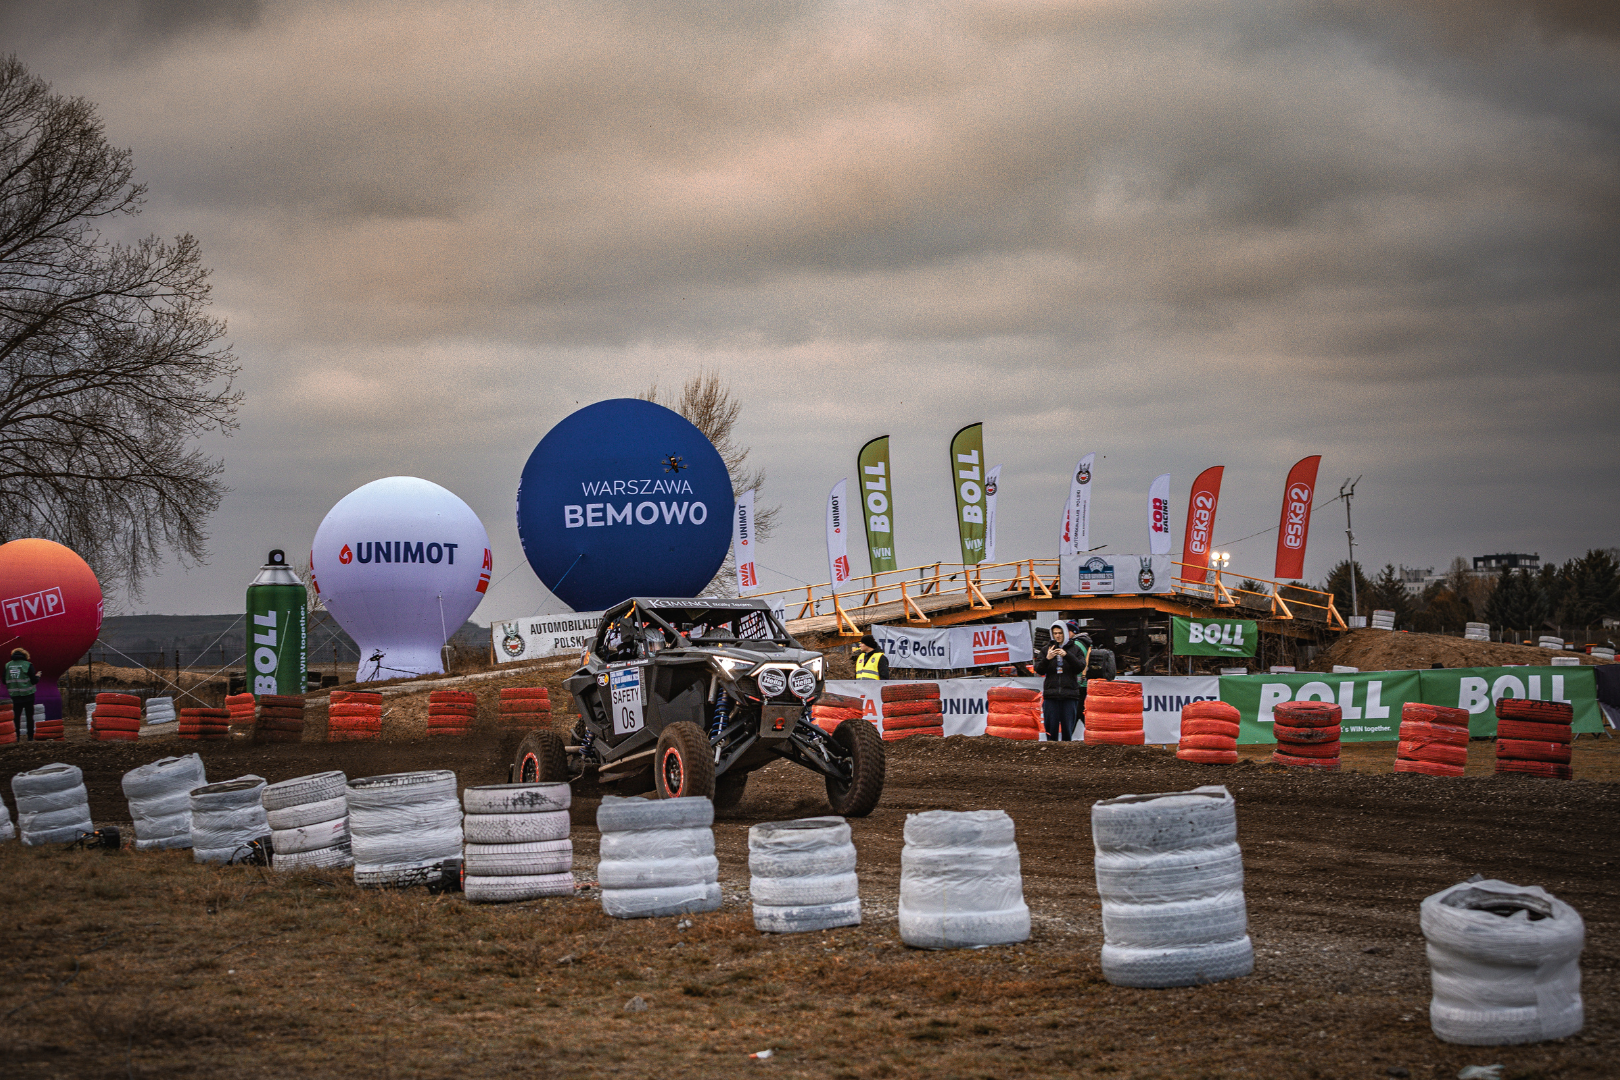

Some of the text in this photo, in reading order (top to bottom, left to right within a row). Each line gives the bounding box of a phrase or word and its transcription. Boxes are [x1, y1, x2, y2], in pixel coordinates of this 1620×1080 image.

[582, 479, 693, 496] WARSZAWA
[864, 461, 890, 532] BOLL
[957, 449, 983, 524] BOLL
[564, 501, 707, 528] BEMOWO
[739, 504, 748, 539] UNIMOT
[832, 495, 840, 527] UNIMOT
[1152, 498, 1163, 533] top
[1192, 496, 1213, 552] eska2
[1287, 488, 1308, 547] eska2
[357, 541, 458, 565] UNIMOT
[873, 547, 891, 558] WIN
[6, 594, 58, 620] TVP
[1189, 622, 1244, 645] BOLL
[254, 610, 277, 695] BOLL
[913, 640, 945, 657] Polfa
[613, 687, 639, 704] SAFETY
[1364, 725, 1391, 733] together.
